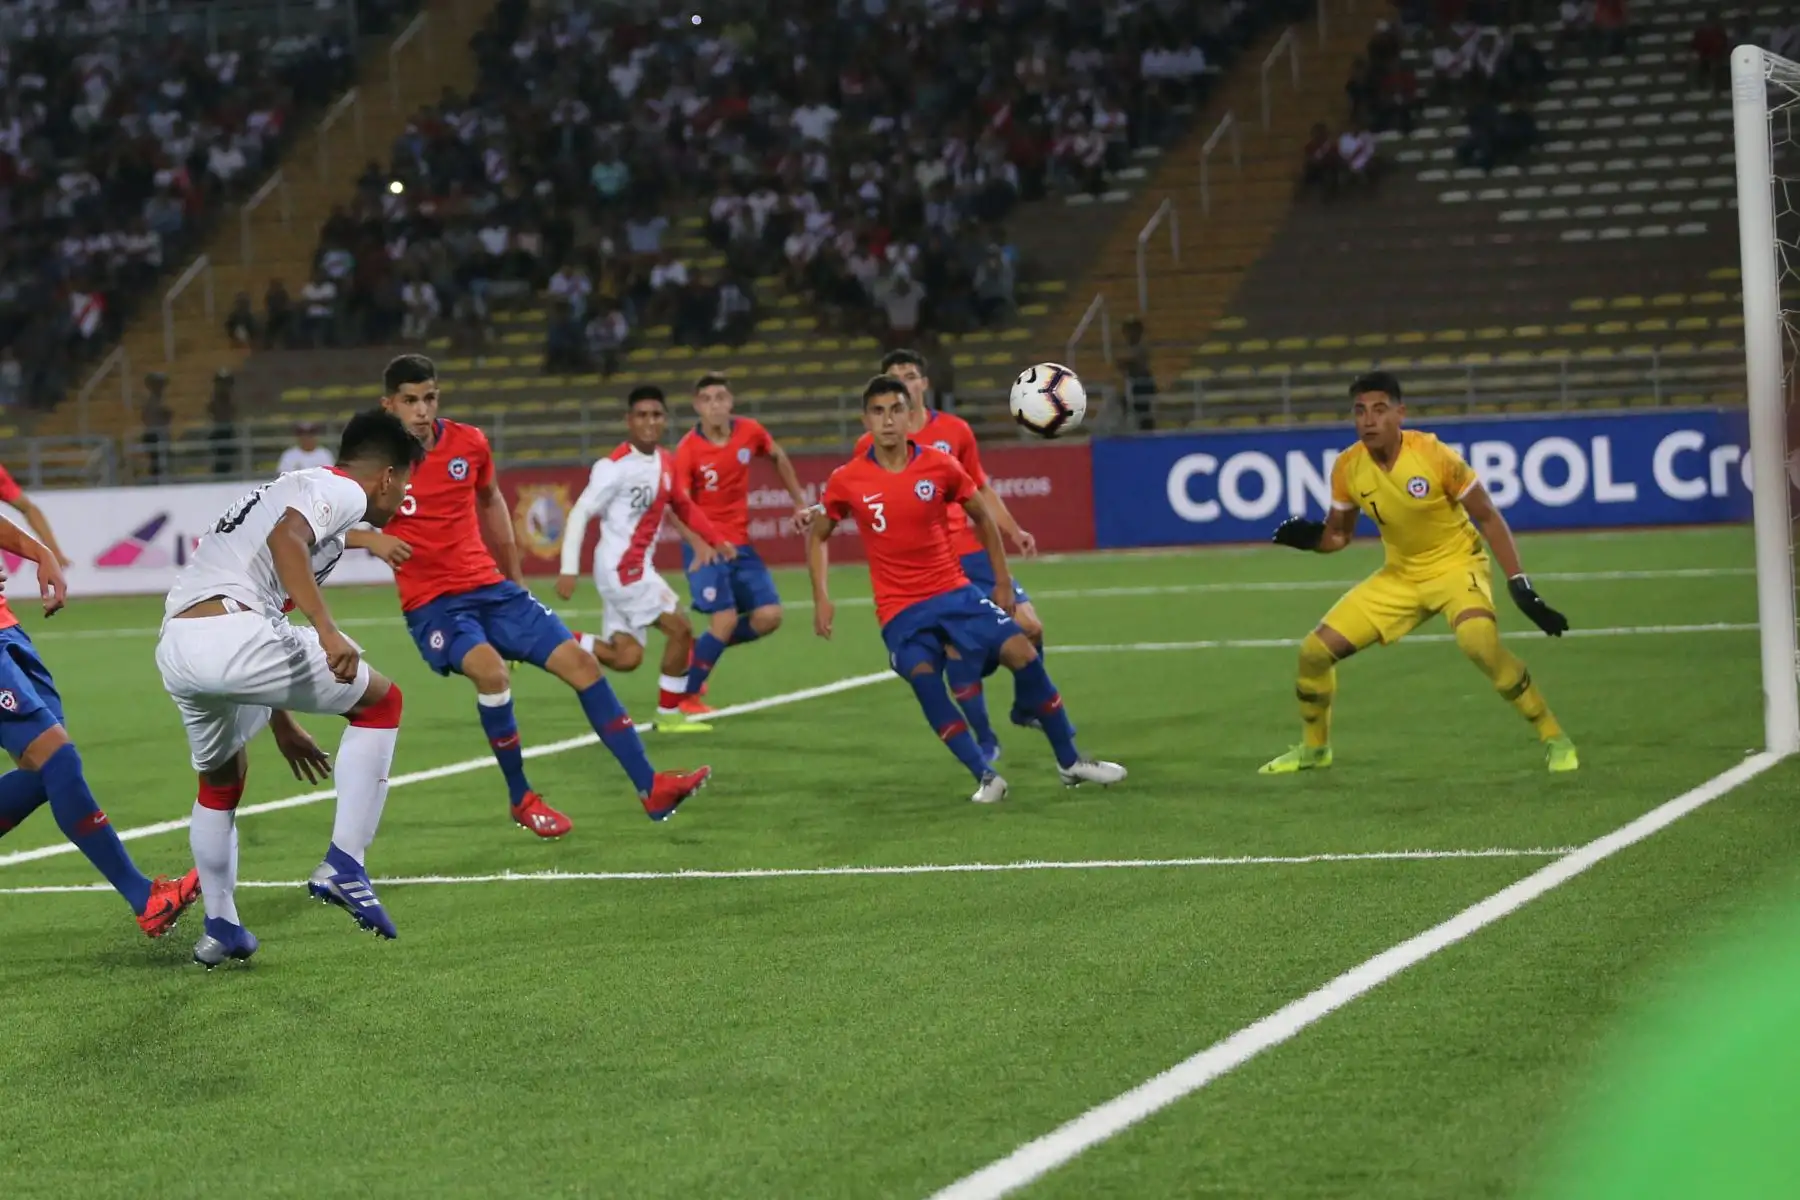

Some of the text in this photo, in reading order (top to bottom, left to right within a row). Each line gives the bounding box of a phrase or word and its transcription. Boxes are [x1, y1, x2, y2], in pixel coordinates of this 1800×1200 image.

[704, 470, 718, 491] 2
[988, 475, 1051, 497] arcos
[1167, 436, 1636, 522] CONBOL
[630, 485, 653, 509] 20
[869, 503, 886, 533] 3
[1370, 501, 1385, 526] 1
